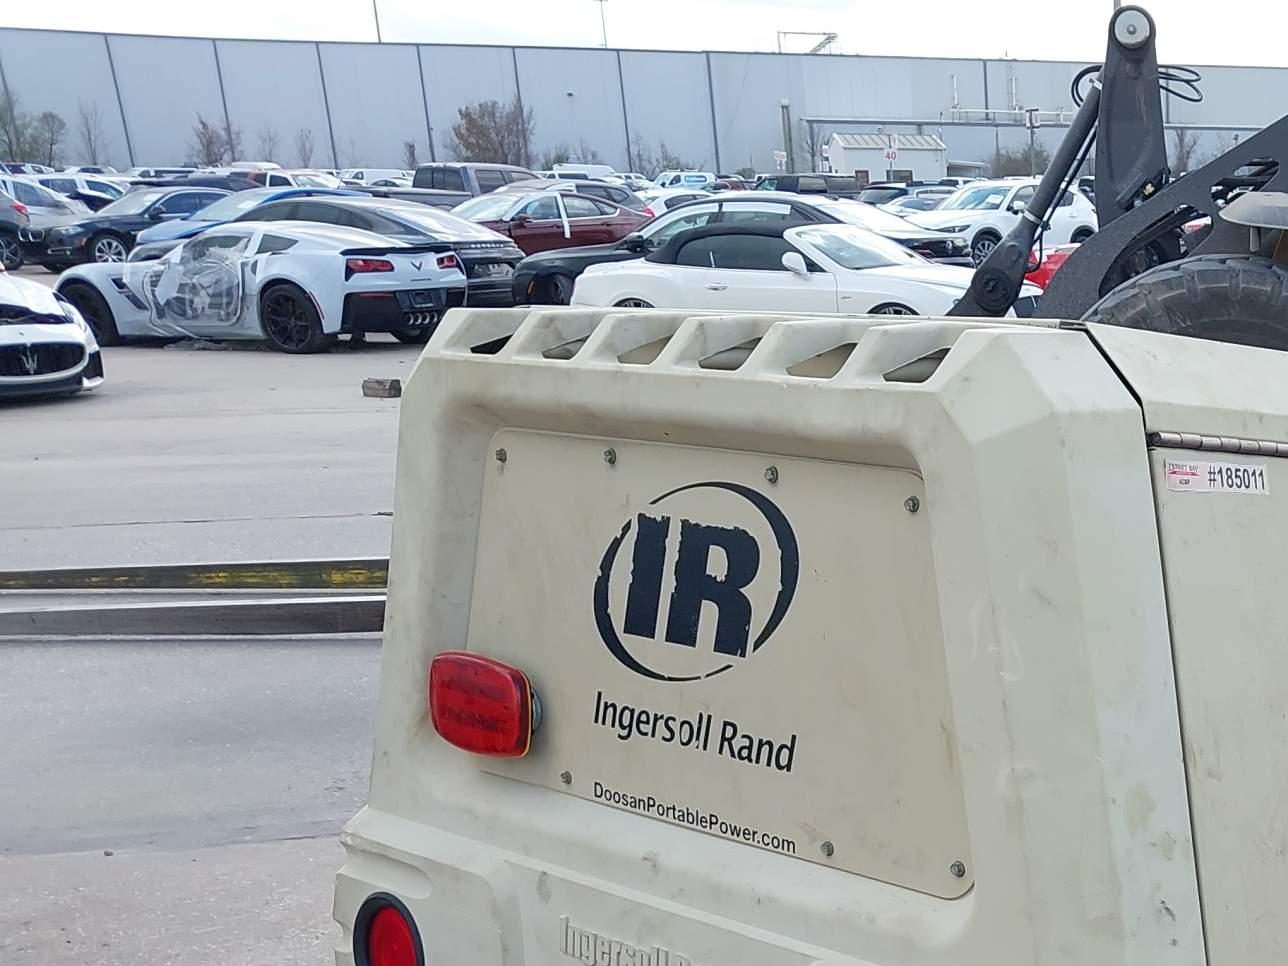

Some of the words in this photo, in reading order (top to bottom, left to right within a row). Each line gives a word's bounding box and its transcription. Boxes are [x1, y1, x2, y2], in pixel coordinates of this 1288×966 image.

[1208, 464, 1265, 490] #185011
[623, 512, 760, 659] IR
[594, 691, 713, 752] Ingersoll
[718, 720, 797, 772] Rand
[594, 781, 796, 854] DoosanPortablePower.com
